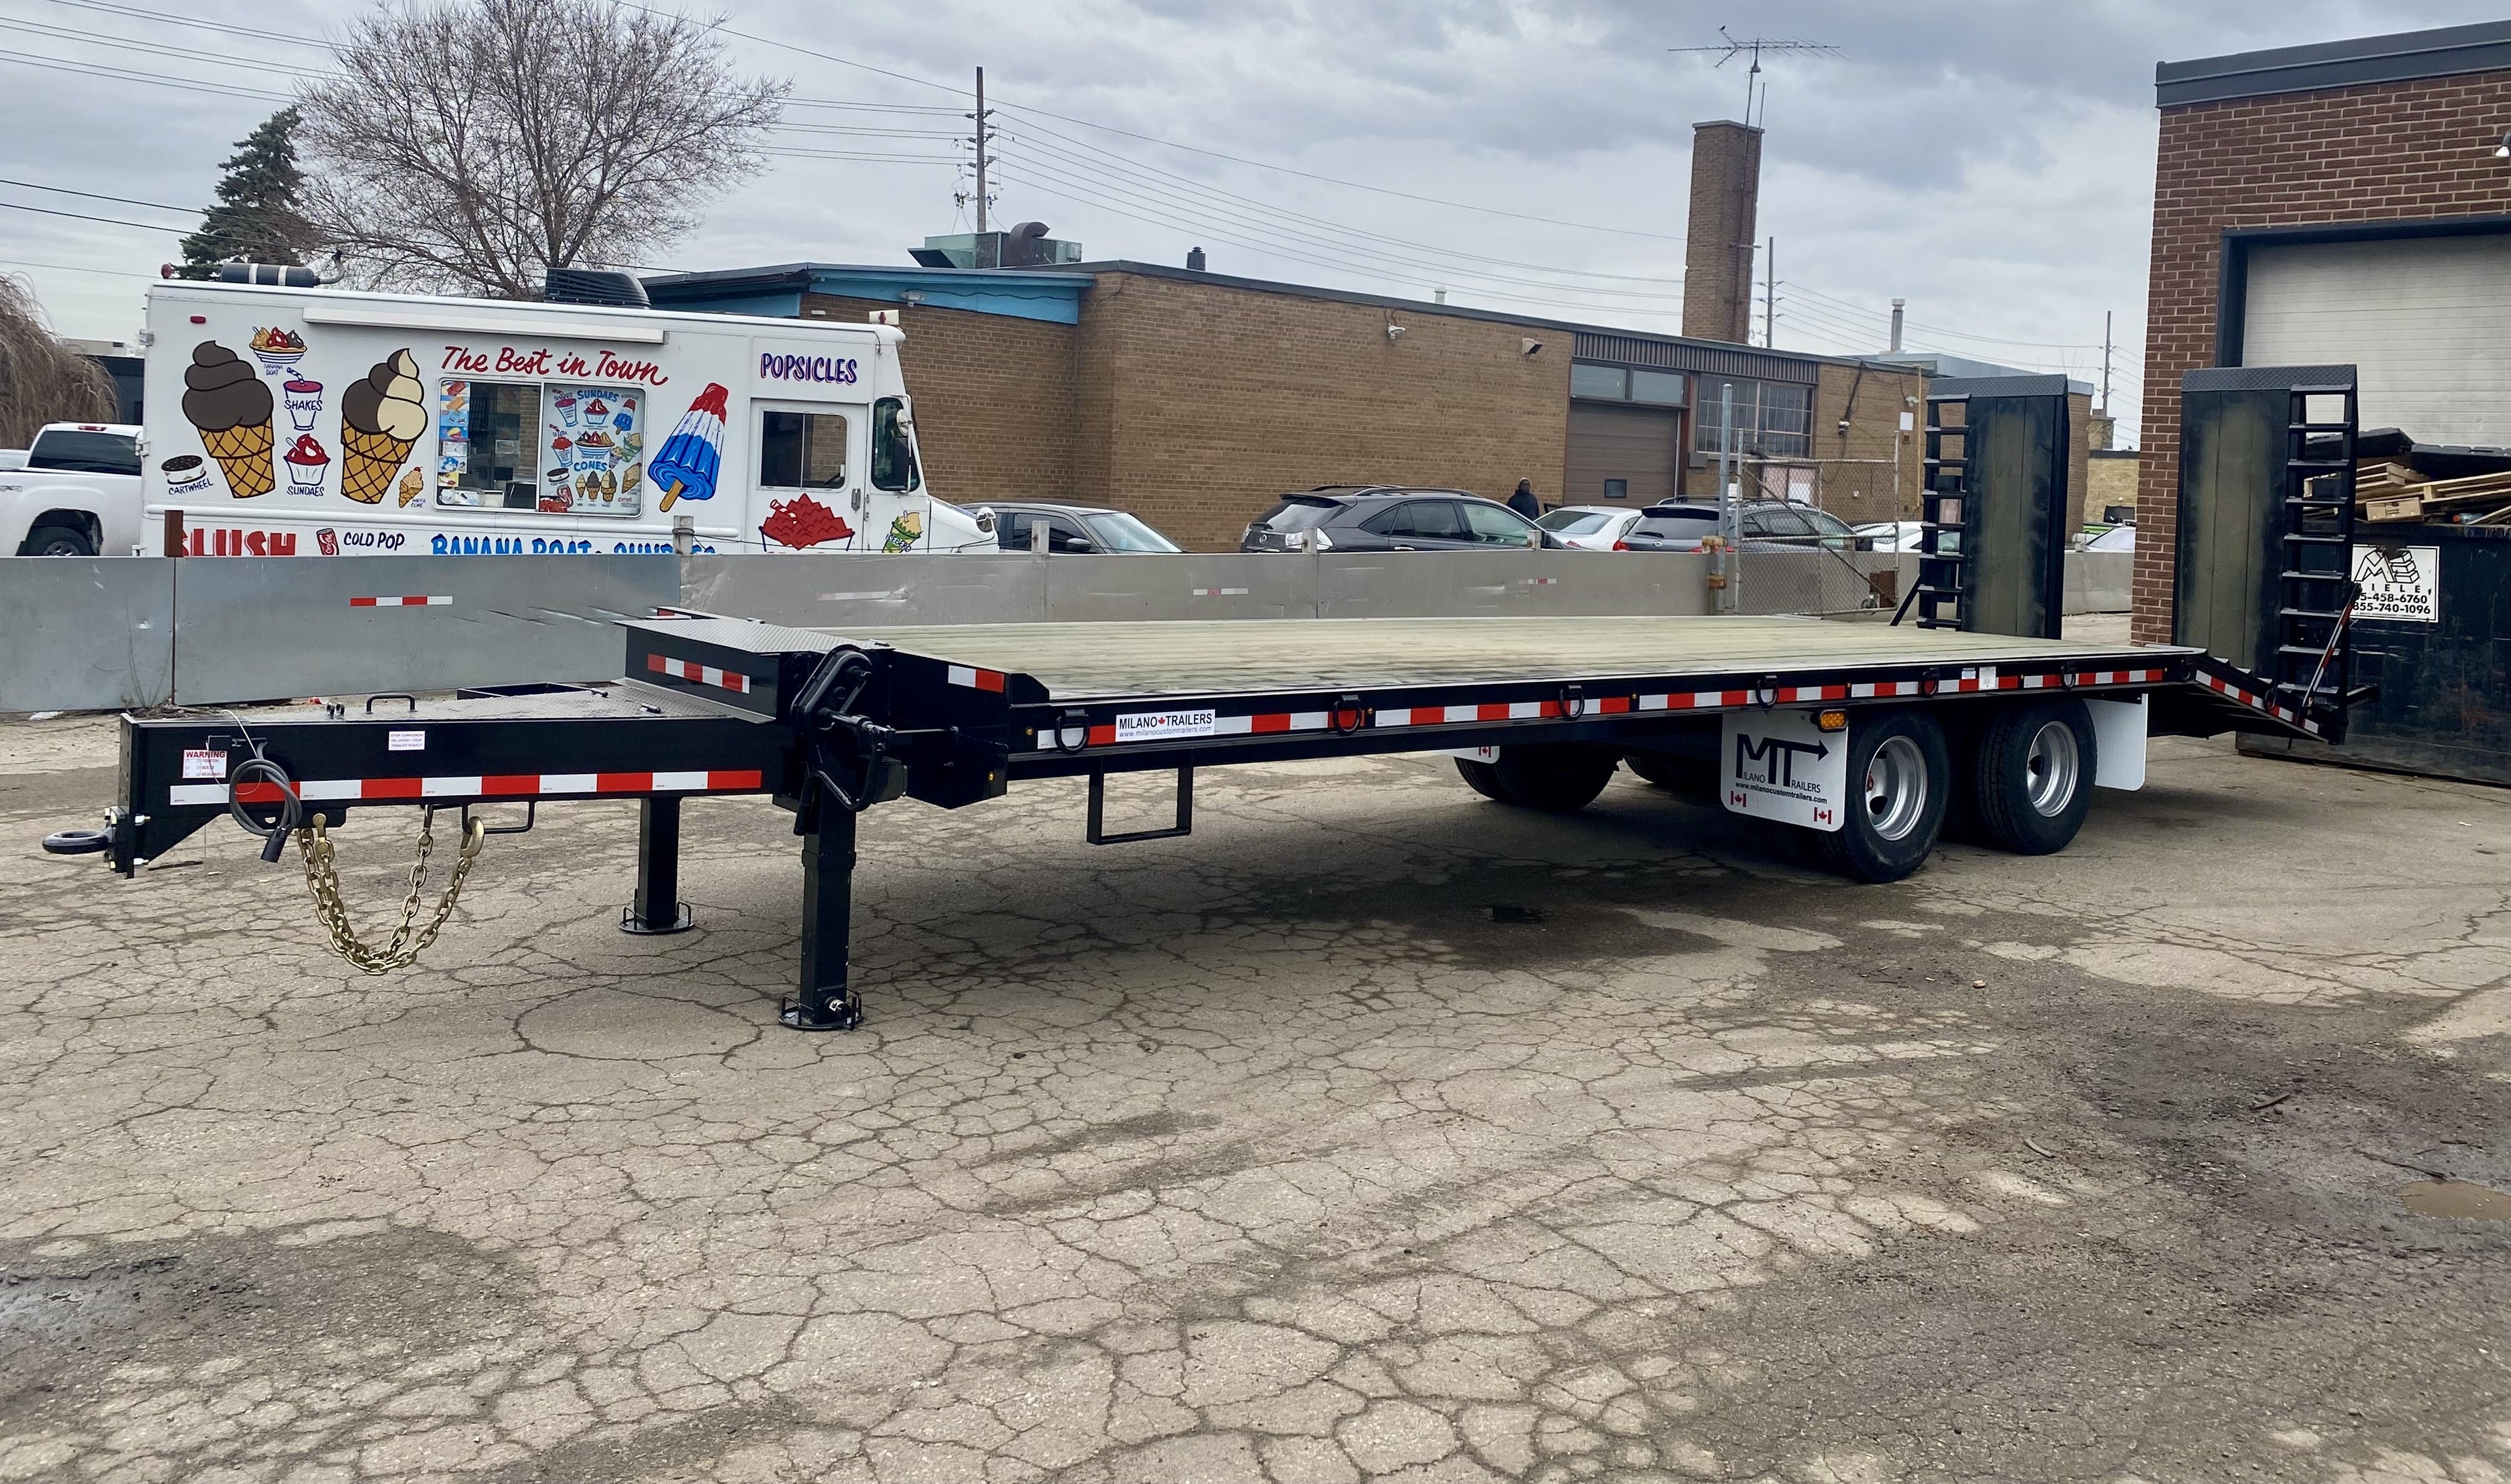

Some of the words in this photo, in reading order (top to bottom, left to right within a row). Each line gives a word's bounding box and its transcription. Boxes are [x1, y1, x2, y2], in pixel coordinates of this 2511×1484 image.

[441, 346, 488, 372] The
[496, 347, 553, 375] Best
[557, 351, 591, 377] in
[596, 350, 668, 386] Town
[760, 353, 857, 385] POPSICLES
[577, 390, 619, 403] SUNDAES
[284, 399, 322, 411] SHAKES
[573, 461, 607, 471] CONES
[169, 477, 214, 496] CARTWHEEL
[286, 486, 324, 497] SUNDAES
[344, 531, 374, 547] COLD
[377, 531, 405, 551] POP
[431, 533, 522, 554] BANANA
[2372, 583, 2421, 593] IELE
[2360, 592, 2428, 604] 5-458-6760
[1119, 717, 1157, 730] MILANO
[1166, 713, 1212, 726] TRAILERS
[1119, 726, 1212, 737] www.milanocustomtrailers.com
[1735, 781, 1828, 804] www.milanocustomtrailers.com
